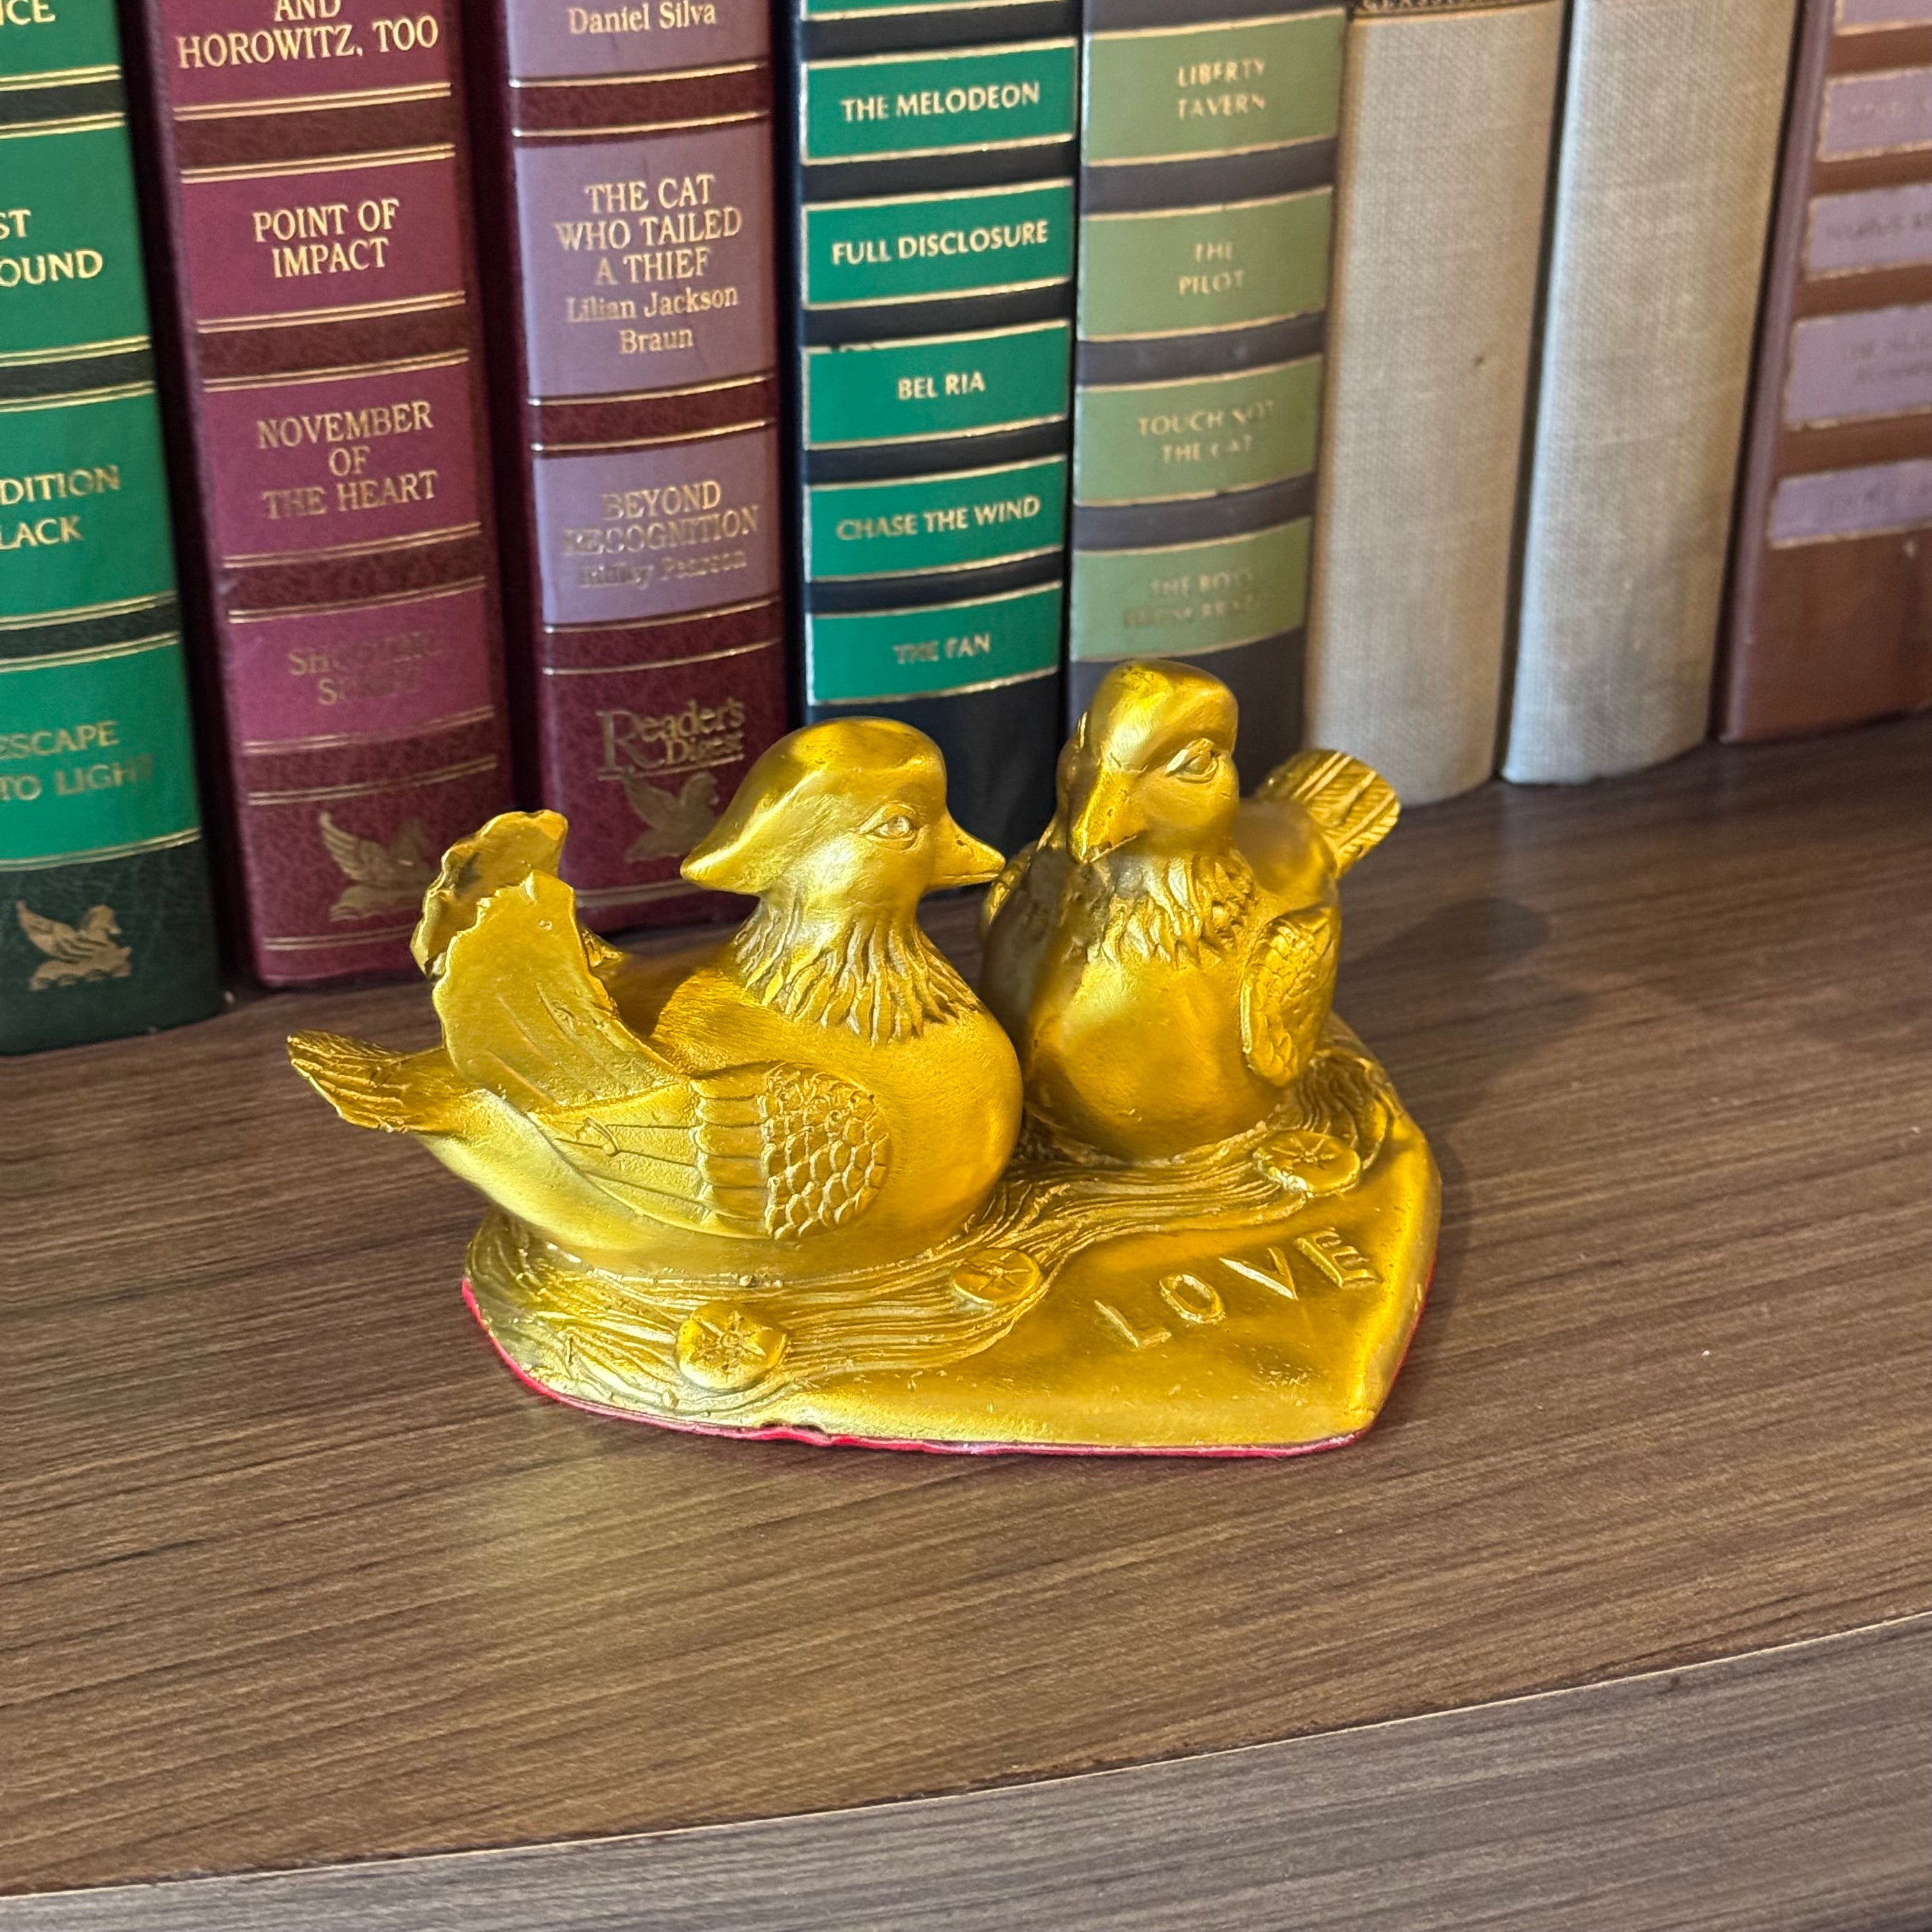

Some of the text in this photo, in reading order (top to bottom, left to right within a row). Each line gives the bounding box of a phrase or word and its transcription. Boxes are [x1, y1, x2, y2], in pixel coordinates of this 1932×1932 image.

[0, 0, 56, 26] CE
[274, 0, 341, 22] AND
[567, 0, 717, 34] Daniel Silva
[371, 15, 439, 53] TOO
[1177, 57, 1265, 88] LIBERTY
[839, 80, 1041, 123] THE MELODEON
[1177, 93, 1267, 121] TAVERN
[584, 173, 716, 214] THE CAT
[252, 197, 401, 243] POINT OF
[555, 206, 742, 251] WHO TAILED
[271, 237, 389, 279] IMPACT
[832, 219, 1050, 266] FULL DISCLOSURE
[0, 248, 103, 288] OUND
[595, 247, 711, 286] A THIEF
[1178, 268, 1244, 296] PILOT
[566, 286, 739, 323] Lilian Jackson
[618, 328, 694, 355] Braun
[898, 371, 986, 401] BEL RIA
[257, 400, 434, 449] NOVEMBER
[1137, 410, 1223, 437] TOUCH
[328, 445, 371, 477] OF
[1162, 442, 1201, 464] THE
[0, 464, 119, 505] DITION
[262, 469, 438, 519] THE HEART
[602, 480, 721, 521] BEYOND
[836, 494, 1041, 540] CHASE THE WIND
[893, 632, 990, 665] THE FAN
[1092, 1227, 1384, 1351] LOVE
